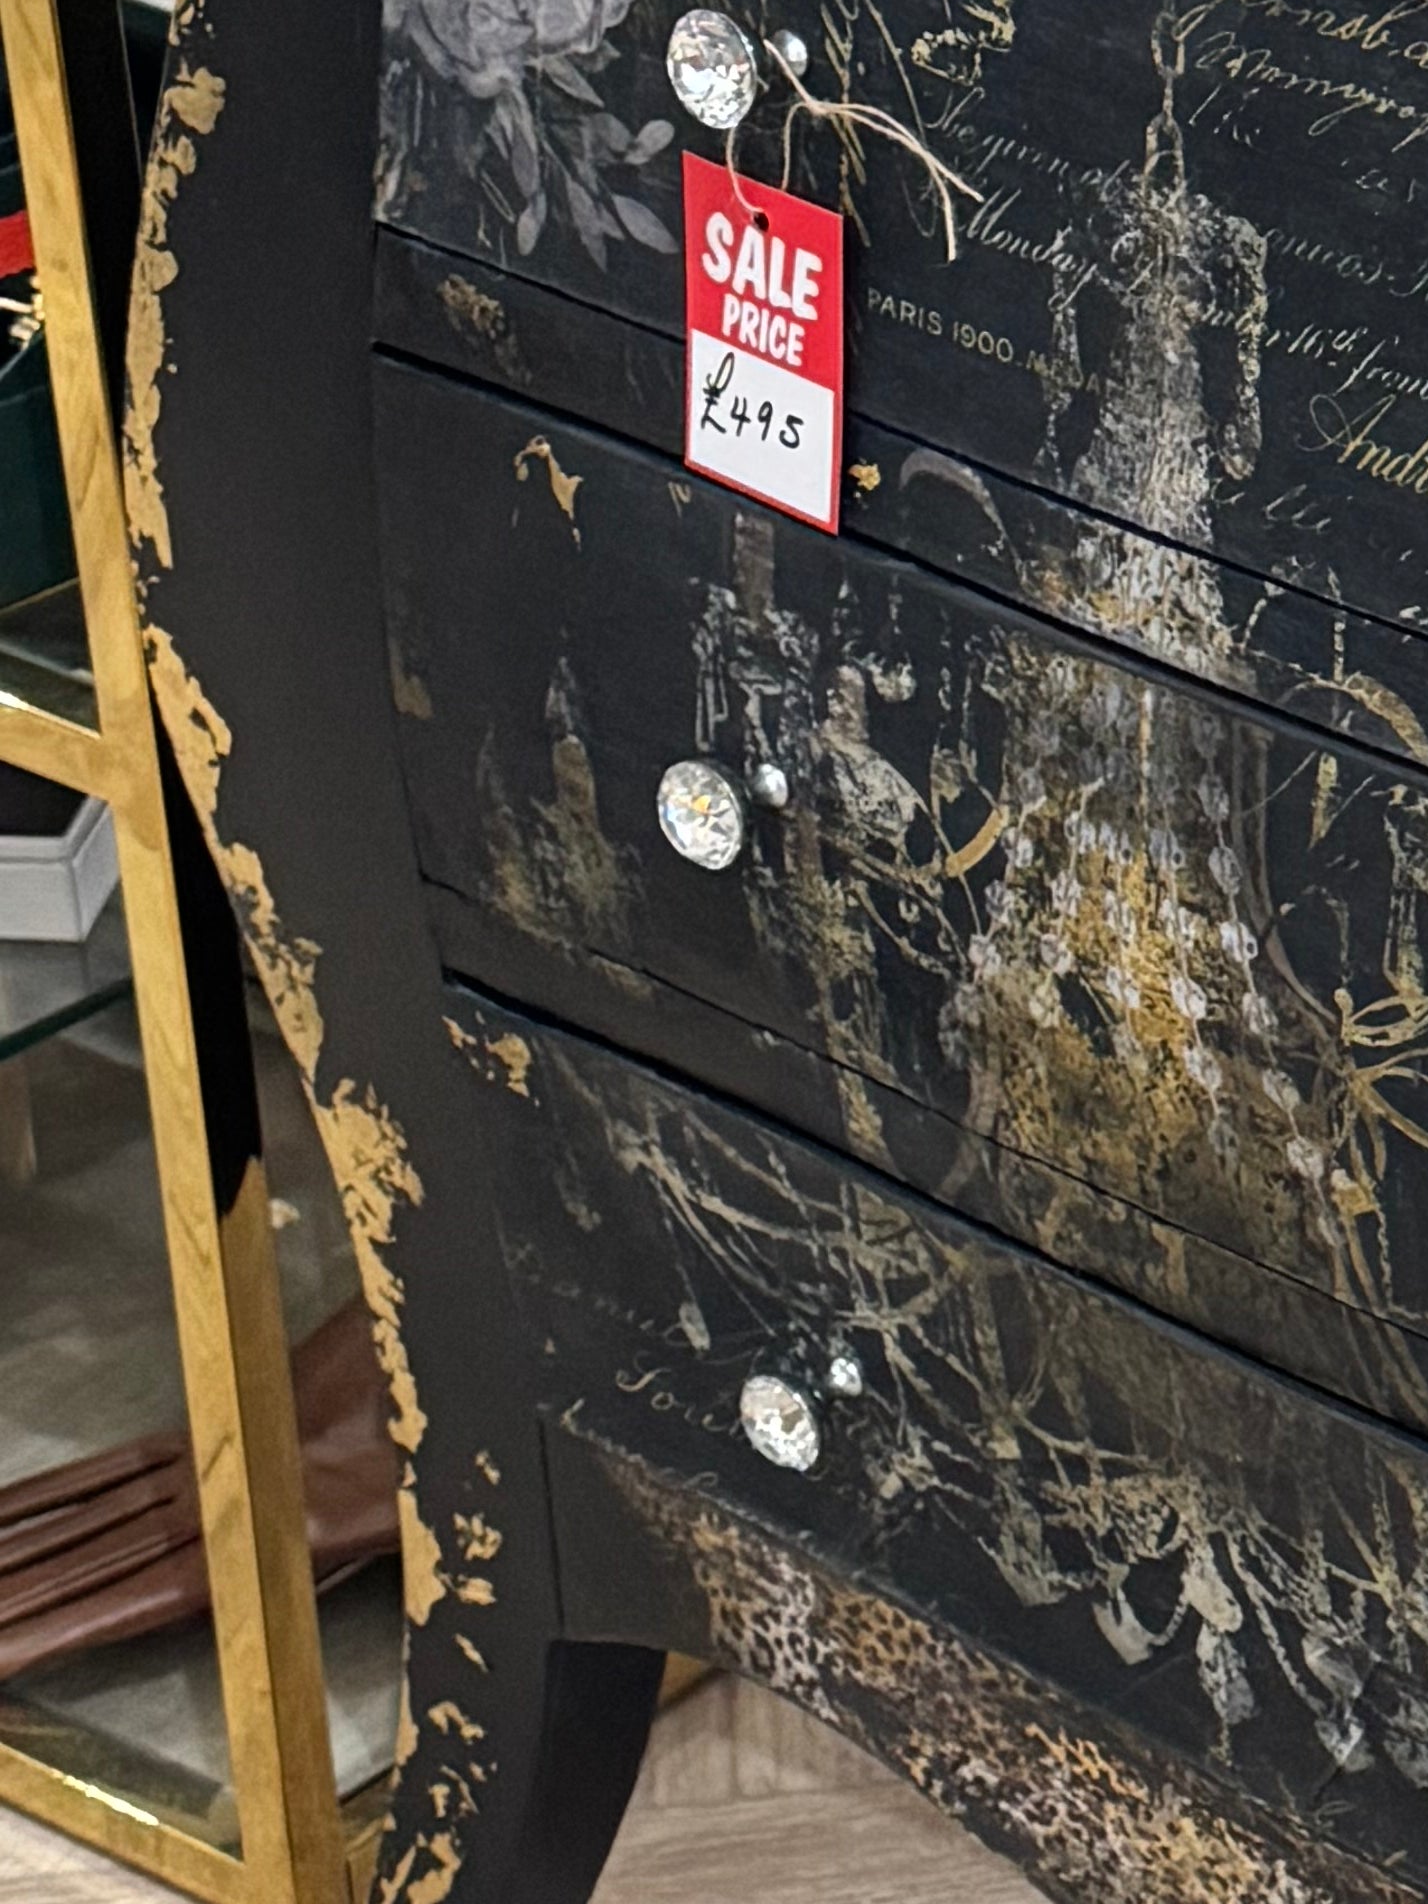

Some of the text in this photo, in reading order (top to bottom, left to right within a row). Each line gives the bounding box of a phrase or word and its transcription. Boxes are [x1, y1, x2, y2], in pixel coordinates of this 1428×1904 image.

[702, 211, 823, 320] SALE
[721, 294, 806, 367] PRICE
[866, 286, 943, 337] PARIS
[701, 351, 805, 449] £495
